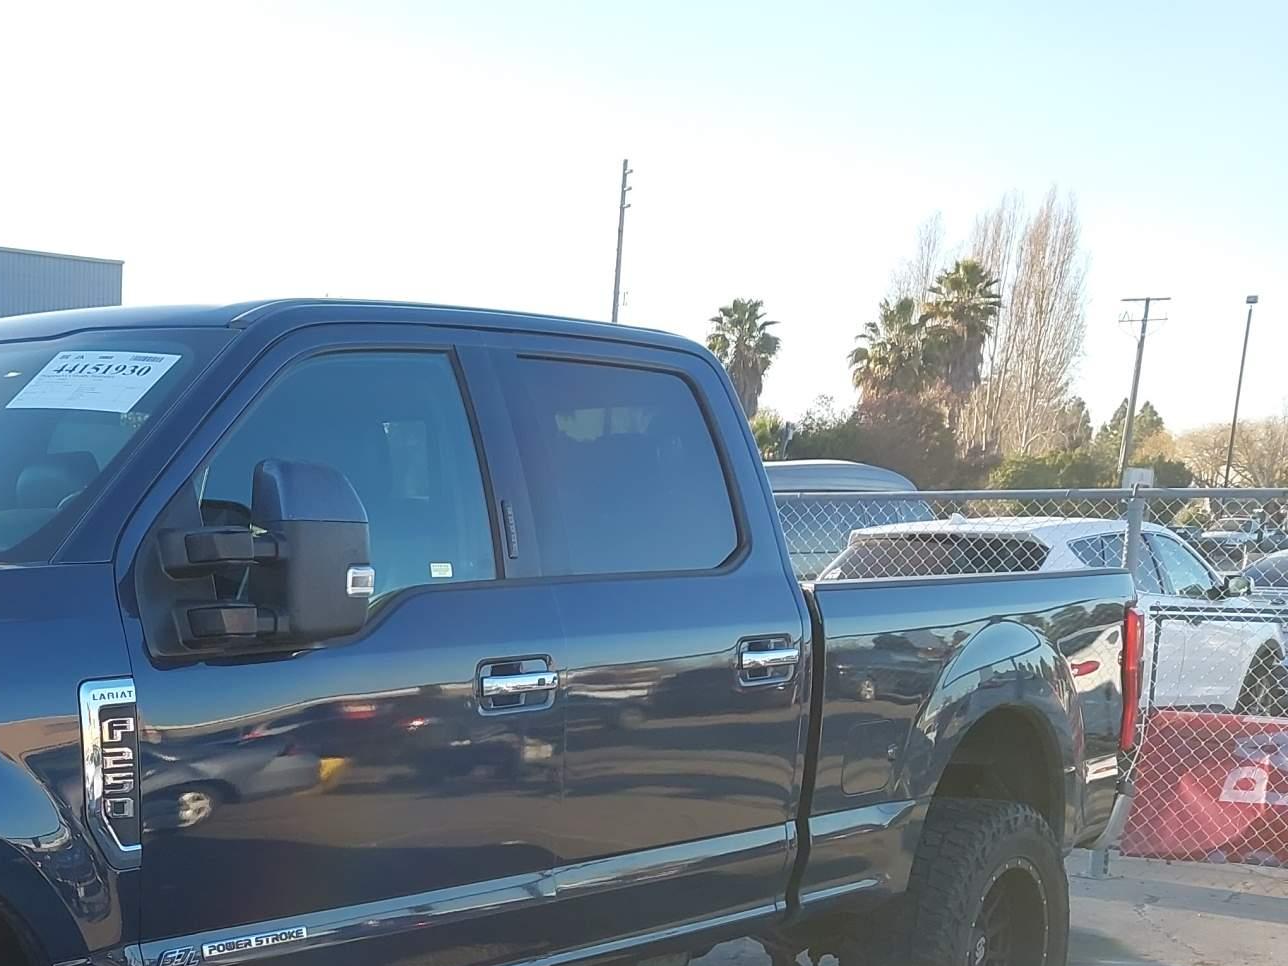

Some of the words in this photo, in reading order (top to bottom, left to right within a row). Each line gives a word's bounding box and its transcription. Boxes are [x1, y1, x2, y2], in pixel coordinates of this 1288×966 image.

[52, 363, 152, 377] 44151930
[92, 690, 134, 701] LARIAT
[208, 938, 253, 955] POWER
[255, 928, 304, 947] STROKE
